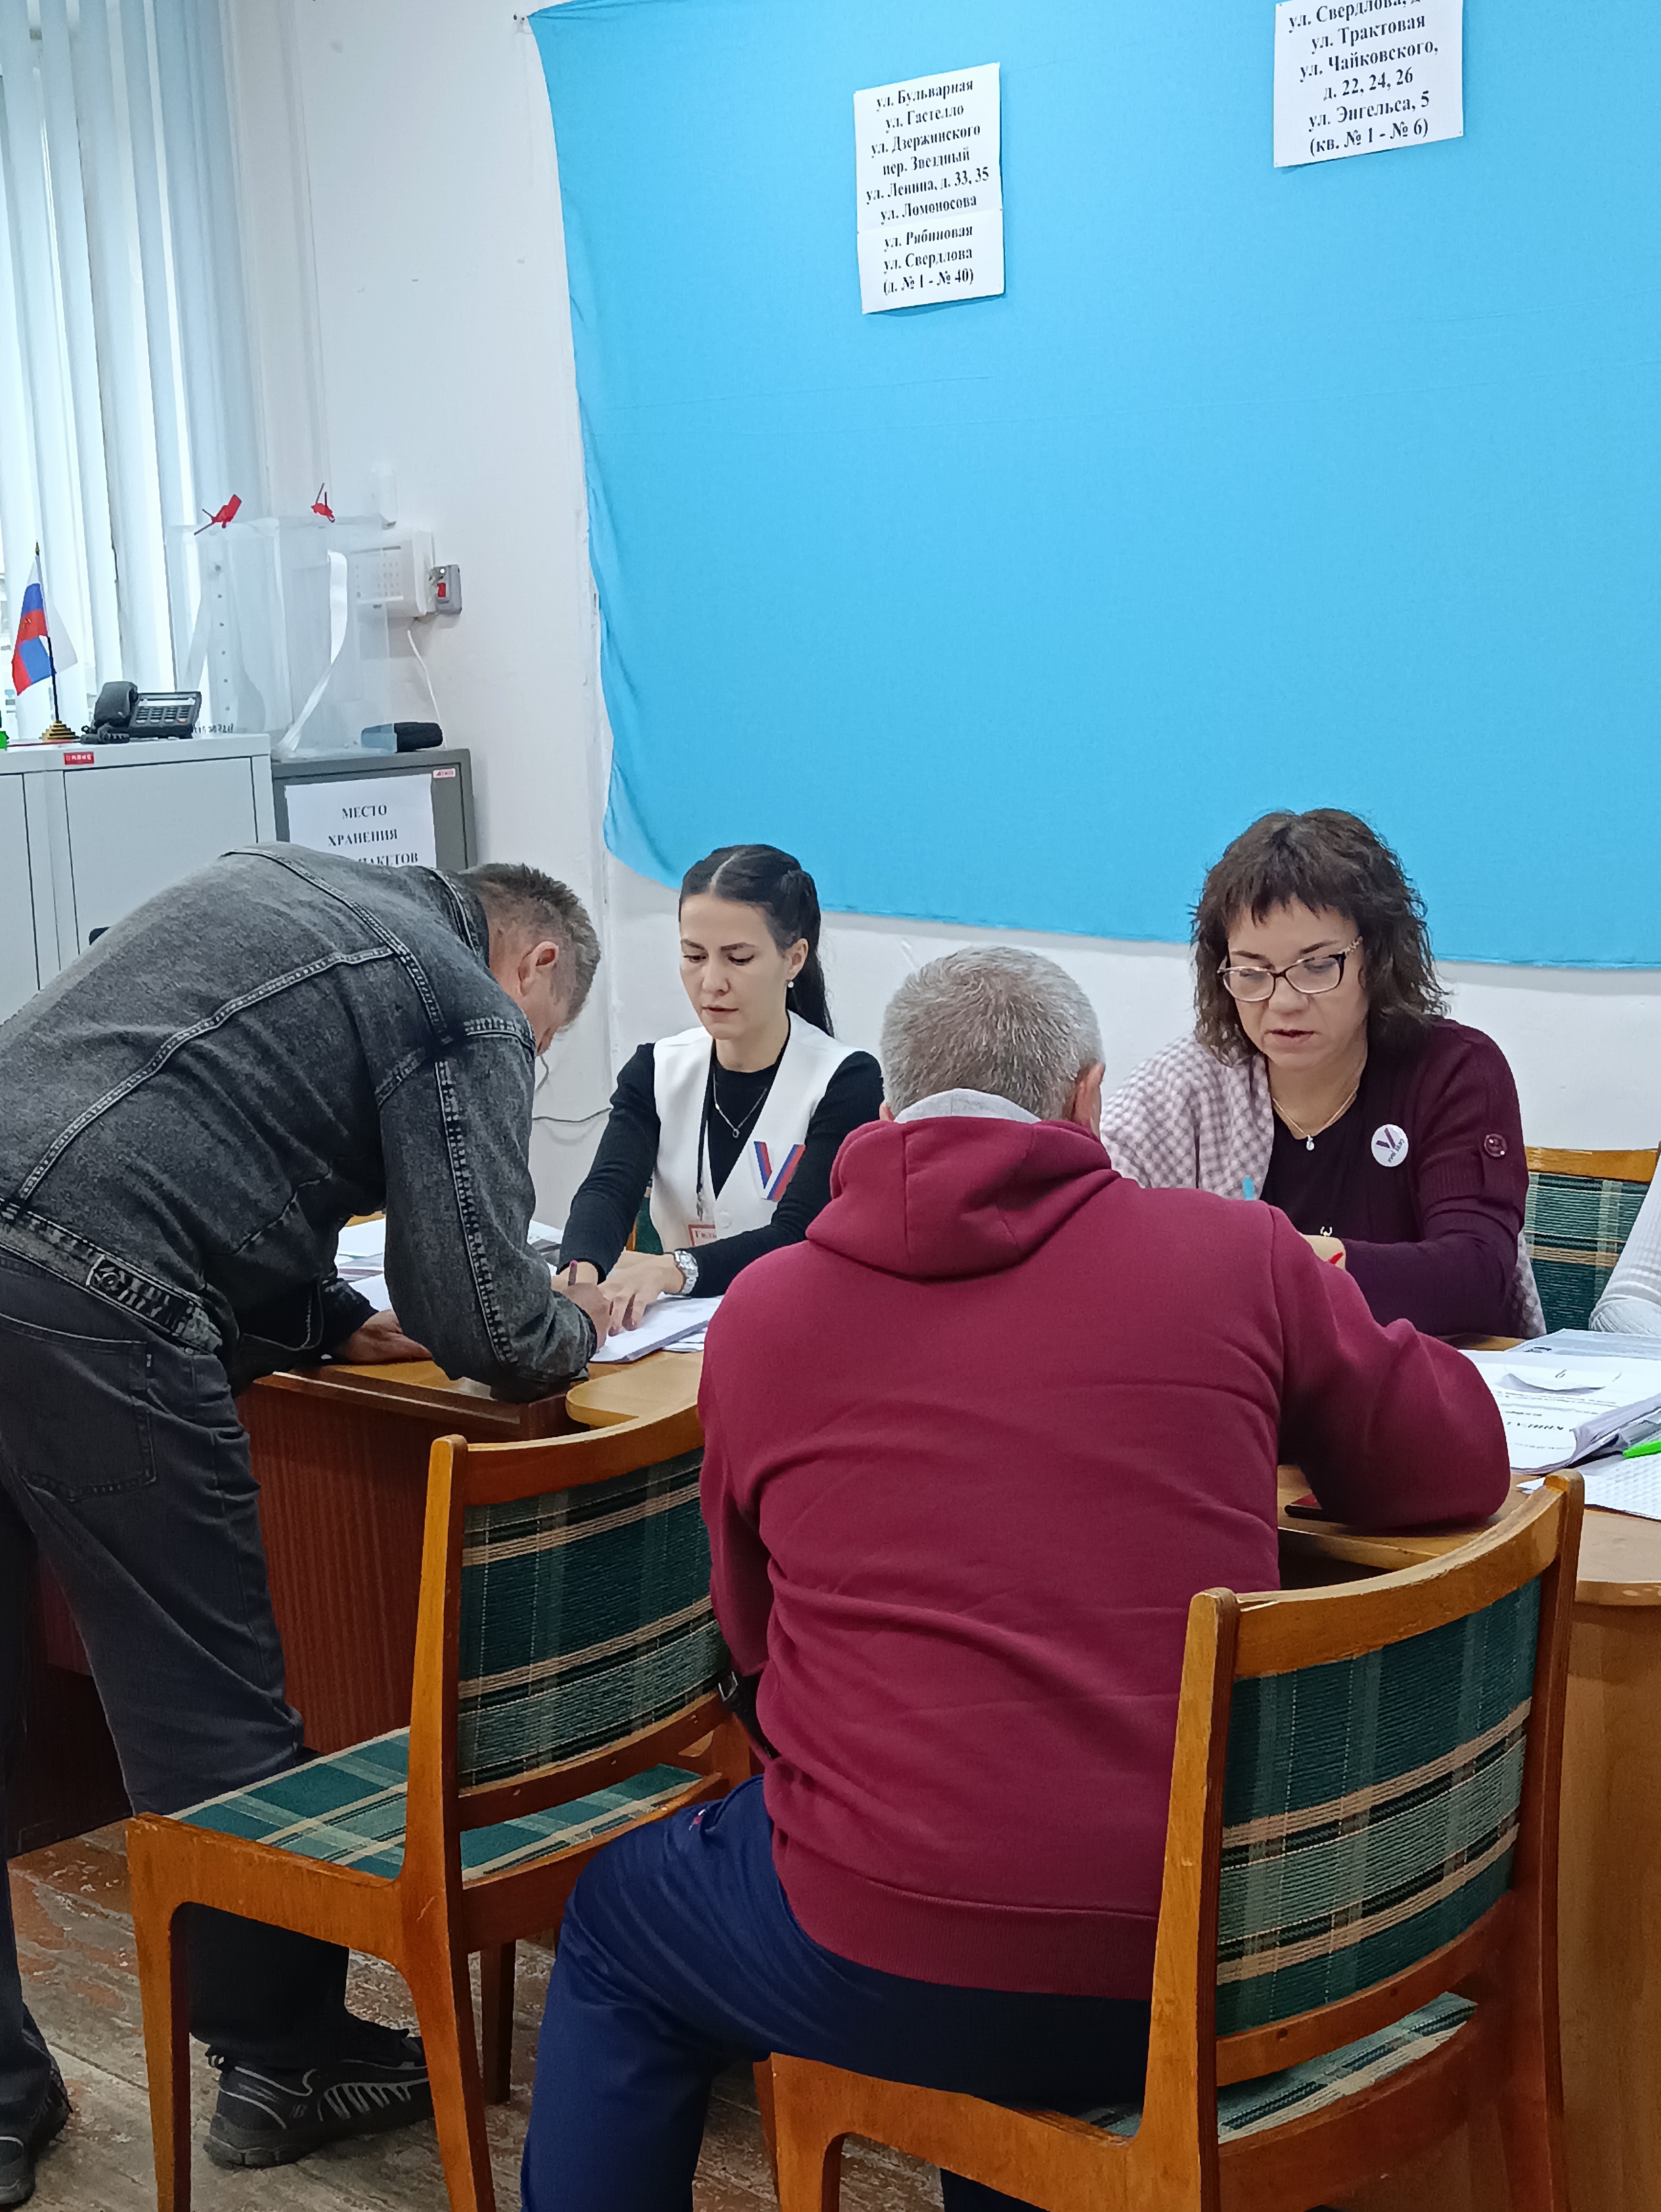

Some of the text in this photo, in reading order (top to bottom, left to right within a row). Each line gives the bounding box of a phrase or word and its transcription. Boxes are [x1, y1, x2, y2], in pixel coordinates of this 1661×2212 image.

[1289, 15, 1311, 33] ул.
[1312, 16, 1425, 55] ул. Трактовая
[1300, 41, 1438, 83] ул. Чайковского,
[876, 80, 973, 112] ул. Бульварная
[1323, 66, 1413, 101] д. 22, 24, 26
[886, 105, 963, 133] ул. Гастелло
[1309, 90, 1429, 132] ул. Энгельса, 5
[872, 125, 980, 158] ул. Дзержинского
[1310, 137, 1339, 157] (кв.
[1344, 130, 1361, 147] №
[1369, 127, 1373, 143] 1
[1390, 121, 1408, 139] №
[1414, 118, 1428, 138] 6)
[883, 146, 969, 177] пер. Звездный
[866, 166, 989, 205] ул. Ленина, д. 33, 35
[881, 196, 976, 225] ул. Ломоносова
[884, 226, 972, 253] ул. Рябиновая
[884, 249, 972, 275] ул. Свердлова
[884, 279, 897, 296] (д.
[901, 276, 914, 291] №
[920, 274, 923, 288] 1
[937, 271, 951, 286] №
[955, 268, 974, 285] 40)
[342, 805, 387, 819] МЕСТО
[328, 829, 397, 846] ХРАНЕНИЯ
